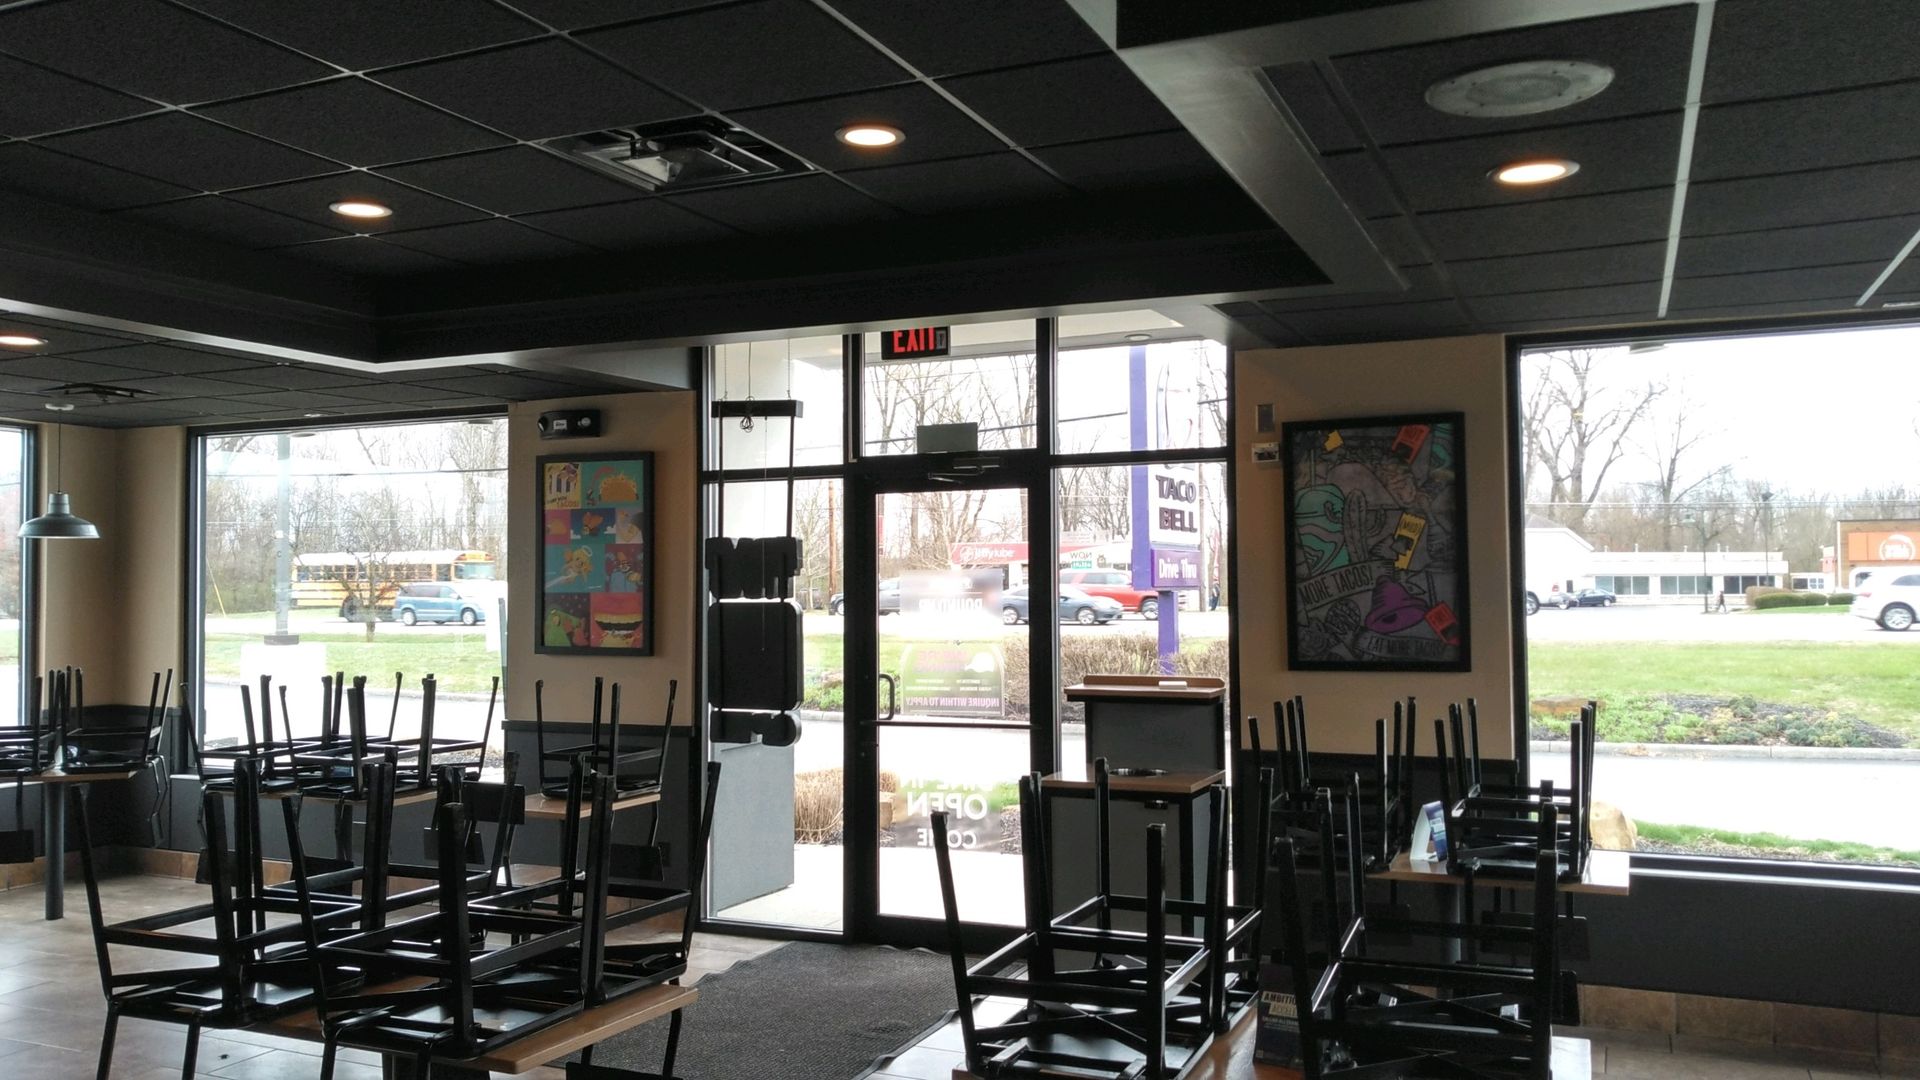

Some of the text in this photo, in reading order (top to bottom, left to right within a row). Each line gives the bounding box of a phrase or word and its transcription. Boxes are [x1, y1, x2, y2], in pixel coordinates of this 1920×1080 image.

[1156, 475, 1197, 503] TACO
[1159, 507, 1198, 533] BELL
[1158, 558, 1197, 579] Drive Thru
[1299, 564, 1375, 607] MORE TACOS!
